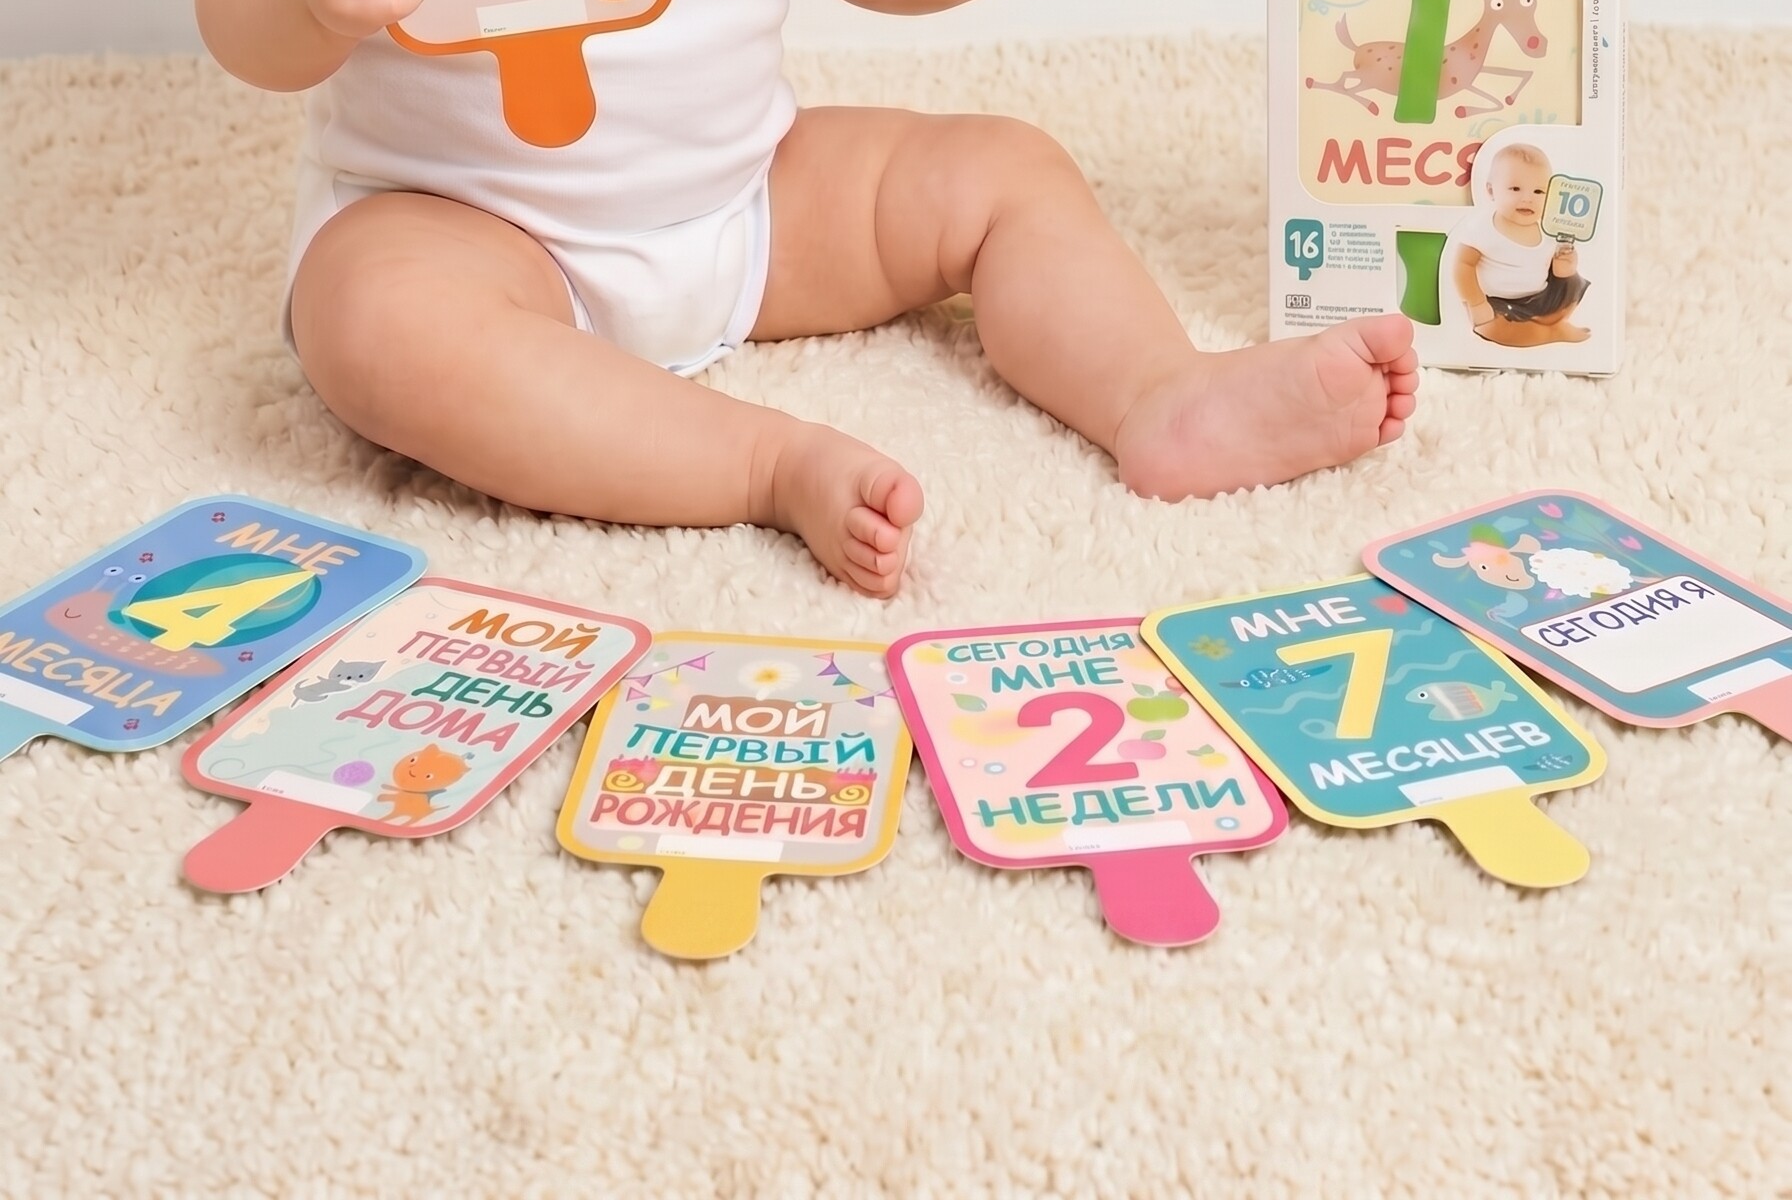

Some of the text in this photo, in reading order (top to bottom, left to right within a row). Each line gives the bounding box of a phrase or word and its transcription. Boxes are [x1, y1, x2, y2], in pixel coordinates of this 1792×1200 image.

[1559, 191, 1590, 218] 10
[1289, 230, 1320, 259] 16
[214, 522, 361, 575] МНЕ
[121, 569, 317, 652] 4
[1679, 580, 1716, 600] Я
[447, 608, 602, 660] МОЙ
[1230, 596, 1367, 643] МНЕ
[397, 629, 596, 694] ПЕРВЫЙ
[946, 631, 1136, 663] СЕГОДНЯ
[0, 631, 182, 717] МЕСЯЦА
[411, 670, 554, 719] ДЕНЬ
[991, 656, 1125, 694] МНЕ
[1275, 628, 1395, 740] 7
[336, 689, 521, 753] ДОМА
[683, 700, 828, 738] МОЙ
[1017, 690, 1140, 790] 2
[626, 722, 877, 766] ПЕРВЫЙ
[1308, 720, 1553, 791] МЕСЯЦЕВ
[645, 765, 829, 801] ДЕНЬ
[974, 777, 1247, 828] НЕДЕЛИ
[589, 792, 869, 840] РОЖДЕНИЯ
